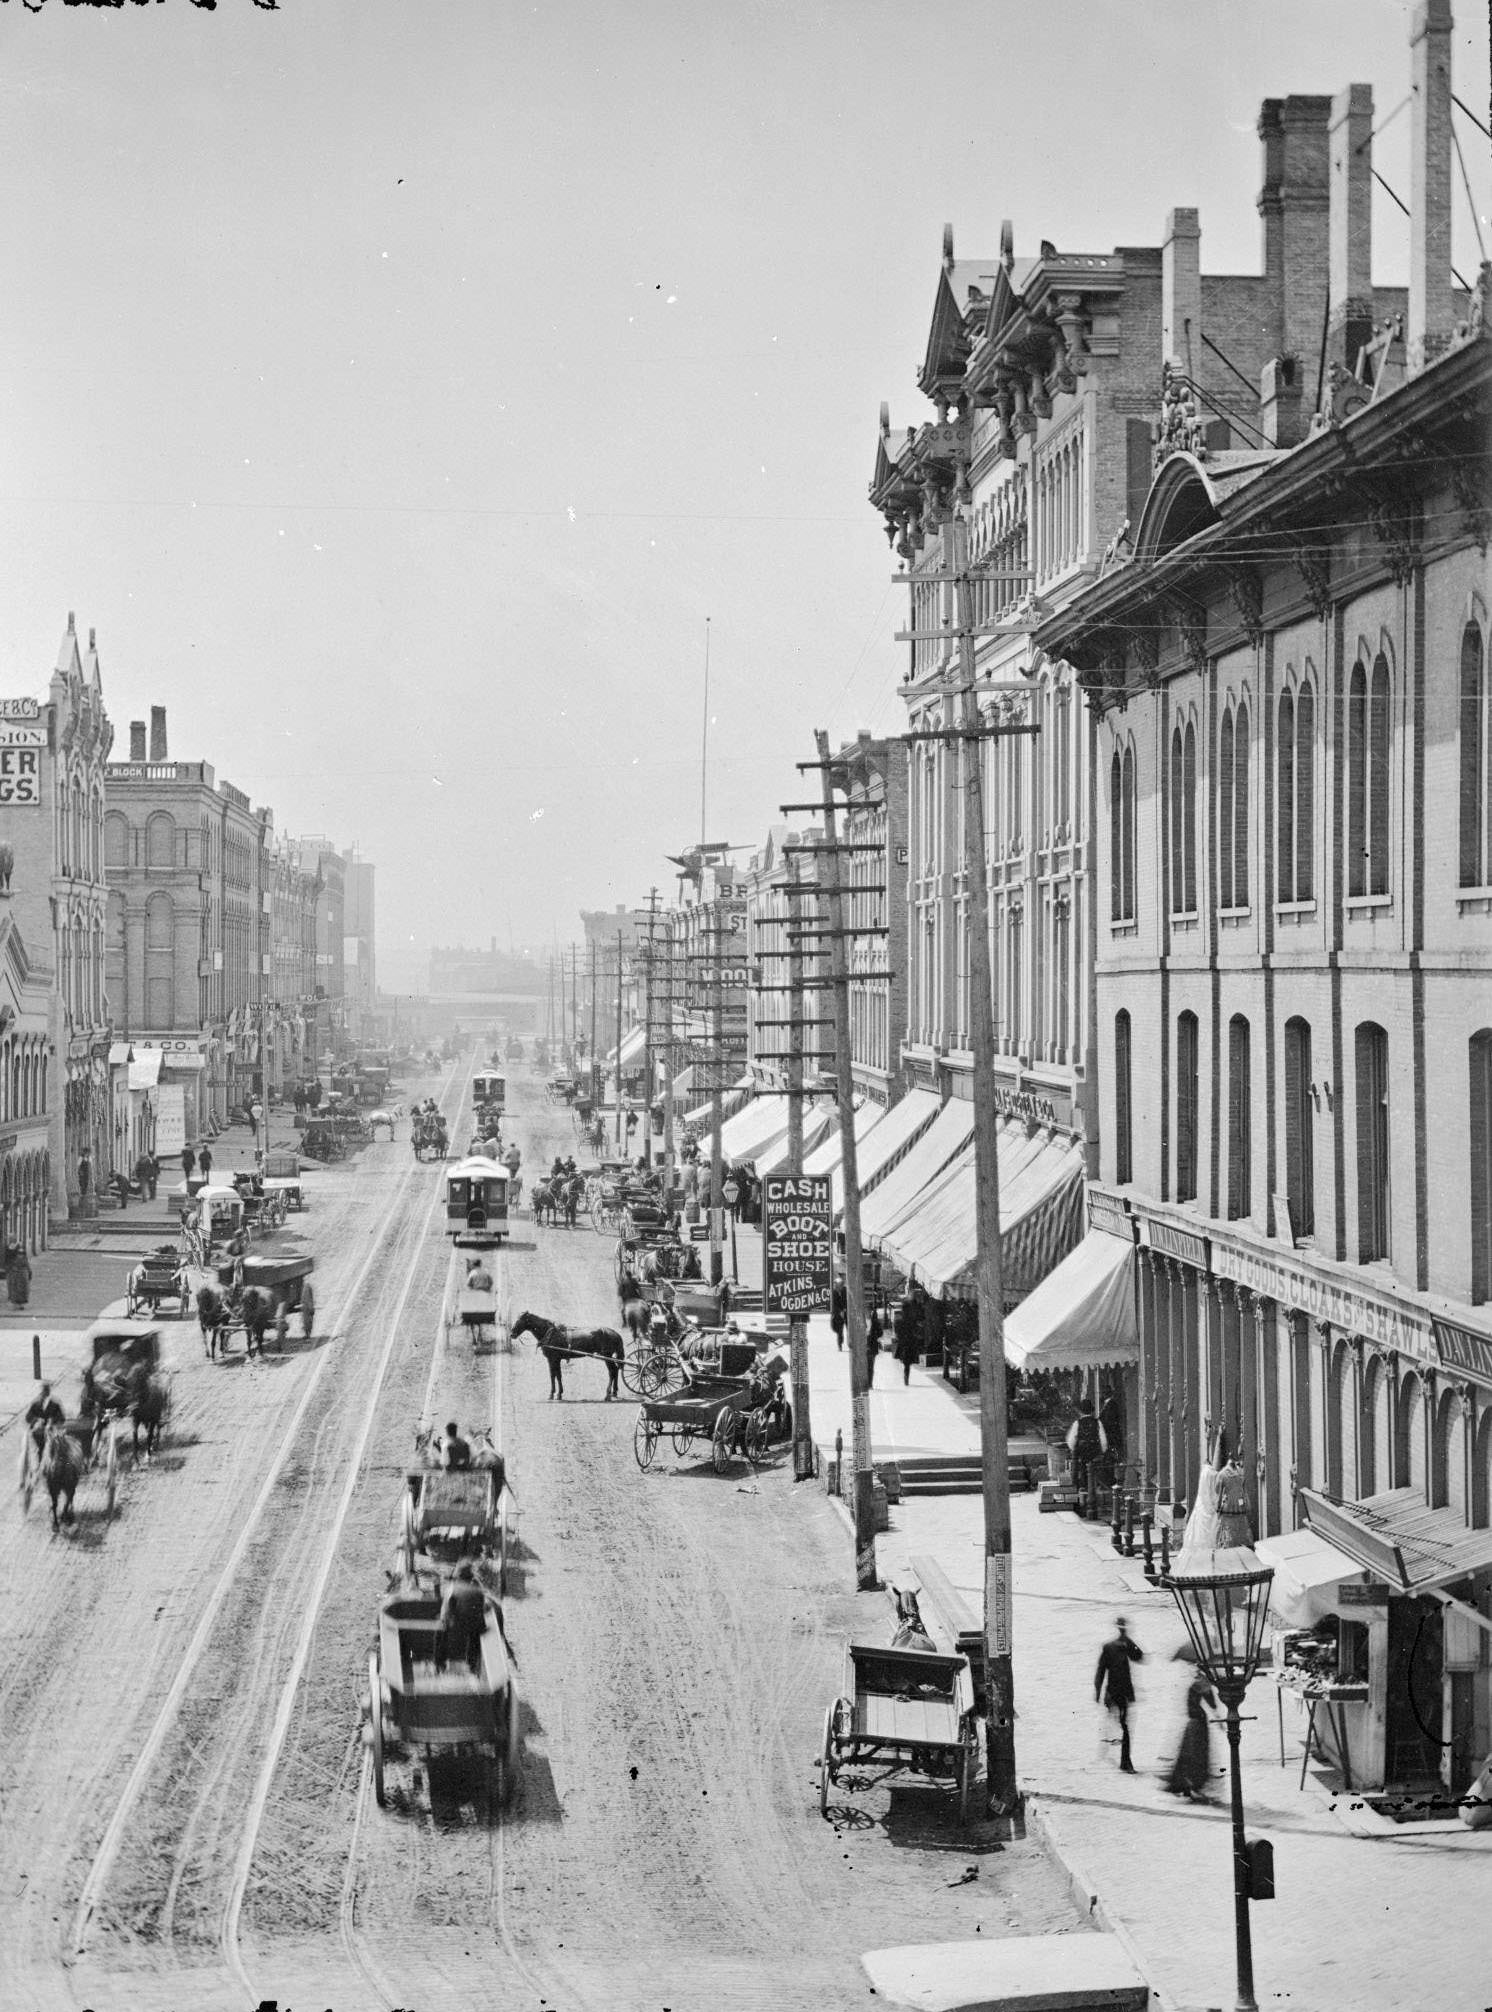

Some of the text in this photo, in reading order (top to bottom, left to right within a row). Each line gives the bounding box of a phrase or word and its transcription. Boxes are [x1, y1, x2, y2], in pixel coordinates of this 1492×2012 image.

[112, 767, 143, 777] BLOCK
[767, 1179, 828, 1200] CASH
[766, 1201, 831, 1215] WHOLESALE
[768, 1215, 830, 1240] BOOT
[790, 1232, 808, 1241] AND
[766, 1241, 830, 1258] SHOE
[771, 1260, 829, 1273] HOUSE.
[1219, 1243, 1244, 1281] DRY
[1289, 1271, 1352, 1328] CLOAKS
[1365, 1300, 1438, 1364] SHAWLS
